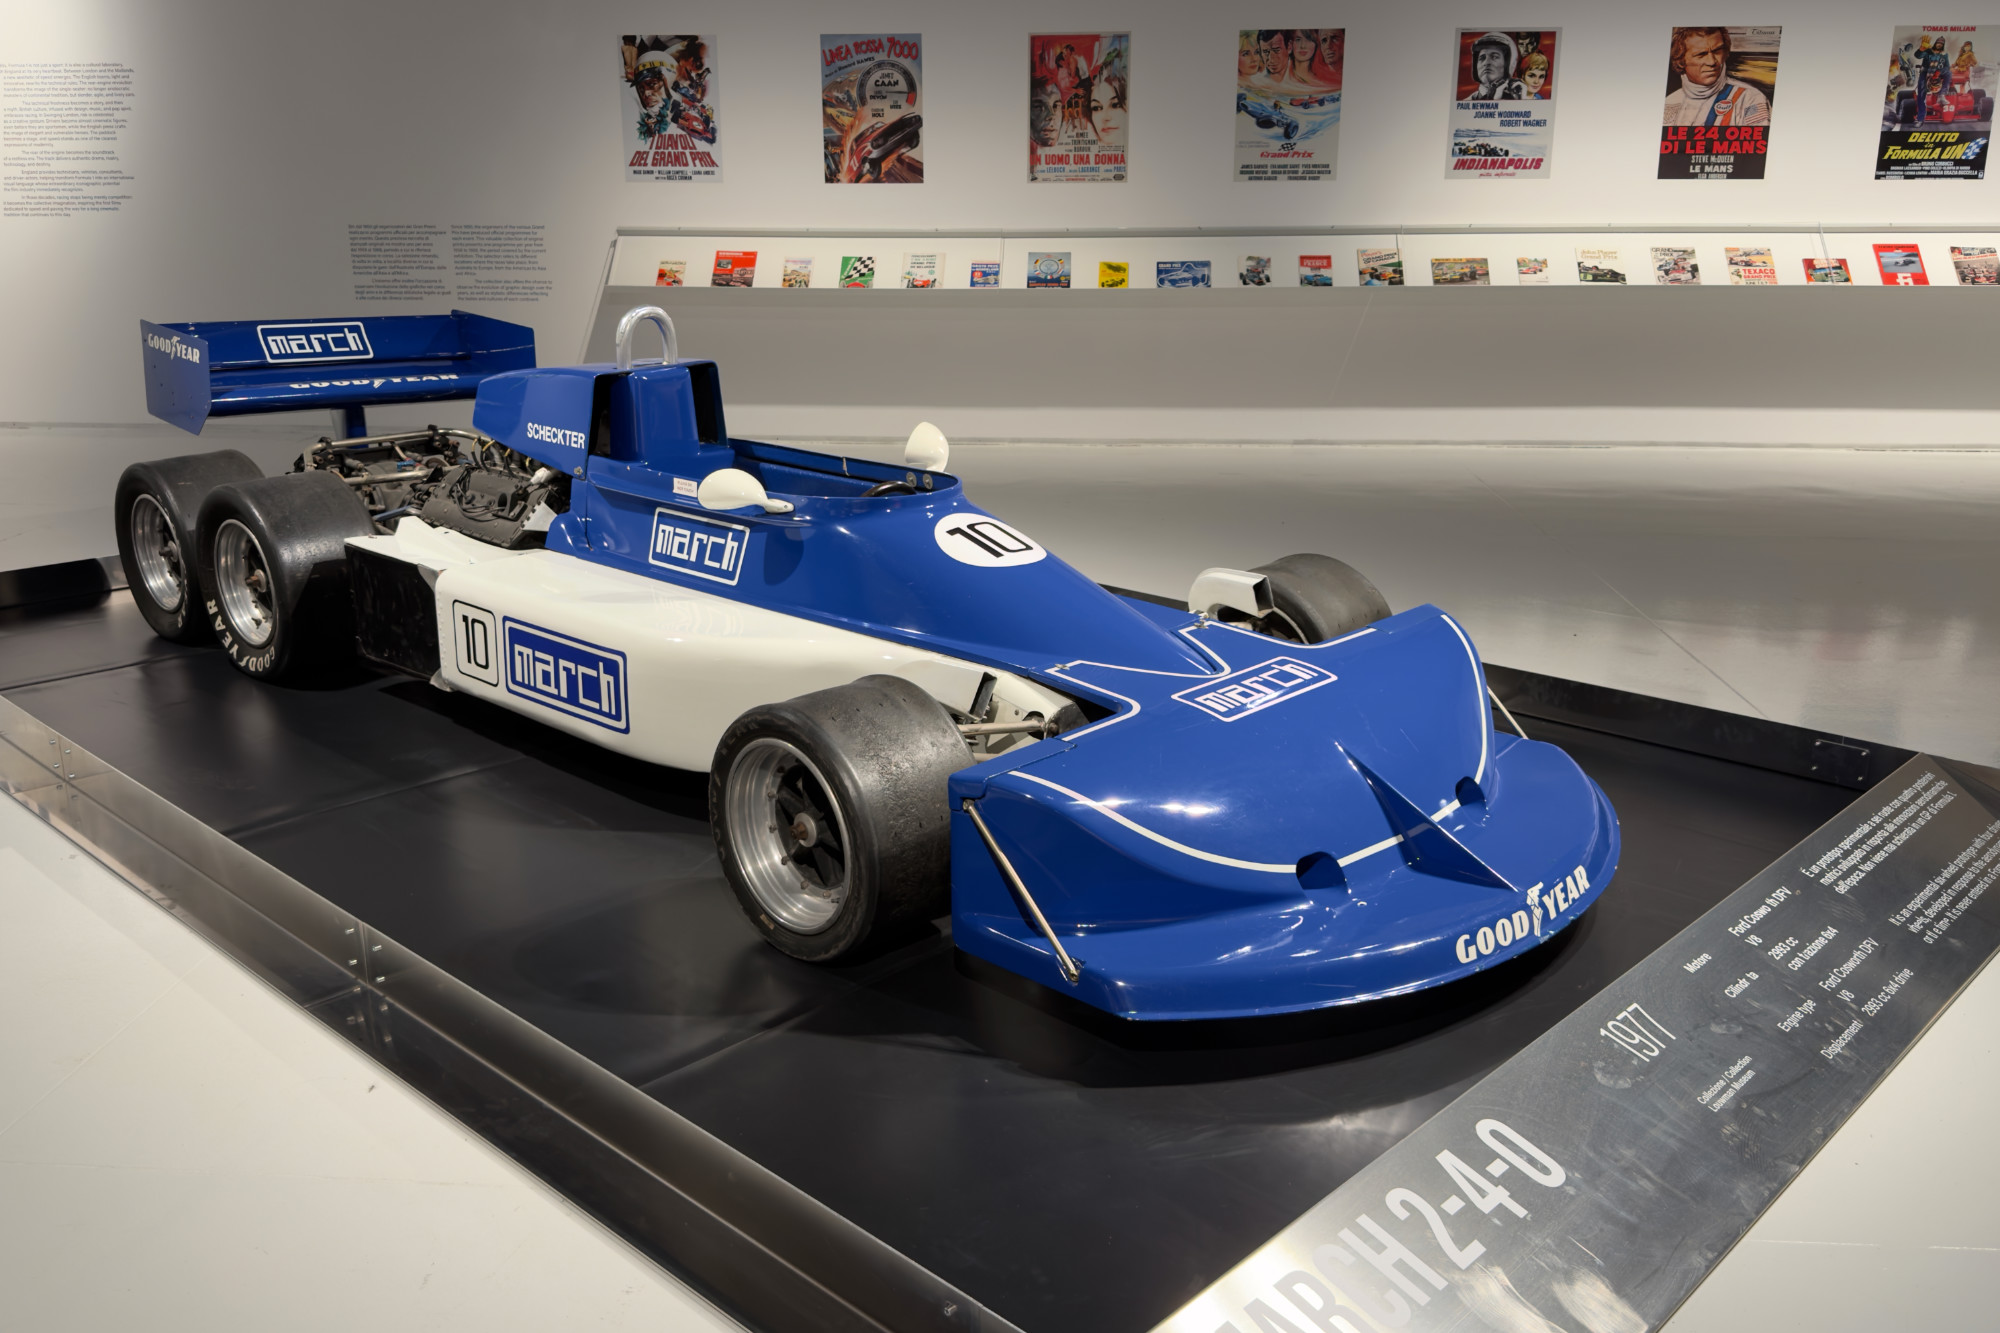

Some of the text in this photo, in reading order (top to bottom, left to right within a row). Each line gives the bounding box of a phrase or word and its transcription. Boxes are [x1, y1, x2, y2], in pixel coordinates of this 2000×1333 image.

[822, 36, 918, 66] LINEA ROSSA 7000
[656, 134, 696, 150] DIAVOLI
[1667, 127, 1764, 140] LE 24 ORE
[1908, 132, 1960, 142] DELITTO
[629, 151, 718, 167] DEL GRAND PRIX
[1030, 154, 1041, 165] UN
[1074, 154, 1090, 165] UNA
[1094, 154, 1126, 165] DONNA
[1660, 141, 1767, 154] DI LE MANS
[1691, 155, 1734, 163] STEVE McQUEEN
[1882, 146, 1941, 160] FORMULA
[1453, 158, 1544, 170] INDIANAPOLIS
[267, 328, 364, 355] march
[527, 422, 586, 450] SCHECKTER
[655, 524, 738, 572] march
[946, 521, 1033, 558] 10
[462, 614, 489, 670] 10
[514, 644, 616, 716] march
[1195, 662, 1318, 712] march
[1889, 802, 1920, 826] innovazioni
[1926, 806, 1938, 814] di
[1930, 794, 1954, 811] Formula
[1883, 822, 1898, 832] alle
[1915, 818, 1928, 826] un
[1920, 810, 1932, 820] GP
[1809, 864, 1822, 874] un
[1838, 824, 1872, 850] sperimentale
[1871, 812, 1884, 823] sei
[1878, 806, 1894, 818] ruote
[1889, 800, 1903, 808] con
[1898, 788, 1918, 803] quattro
[1866, 829, 1890, 848] risposta
[1892, 826, 1917, 846] schierata
[1837, 848, 1867, 871] sviluppato
[1870, 850, 1889, 864] viene
[1883, 841, 1898, 854] mai
[1819, 866, 1844, 886] motrici
[1858, 861, 1876, 872] Non
[1888, 830, 1994, 926] It is an experimental six-wheel prototype with four
[1922, 892, 1952, 918] developed
[1944, 888, 1957, 897] in
[1952, 871, 1976, 892] response
[1972, 860, 1987, 870] the
[1945, 911, 1958, 920] It
[1956, 896, 1974, 912] never
[1968, 879, 1989, 900] entered
[1980, 876, 1993, 884] in
[1728, 886, 1792, 936] Ford Coswoth DFV
[1744, 934, 1763, 947] V8
[1768, 936, 1799, 960] 2993 cc
[1788, 926, 1840, 971] con trazione 6x4
[1683, 952, 1712, 974] Motore
[1818, 937, 1879, 992] Ford Cosworth DFV
[1724, 971, 1760, 998] Cilindrta
[1836, 989, 1855, 1002] V8
[1861, 968, 1914, 1017] 2993 cc 6x4 drive
[1777, 999, 1816, 1032] Engine type
[1600, 1002, 1676, 1062] 1977
[1820, 1020, 1863, 1059] Displacement
[1697, 1055, 1753, 1105] Collezione / Collection
[1708, 1070, 1756, 1113] Louwman Museum
[1384, 1118, 1567, 1270] 2-4-0
